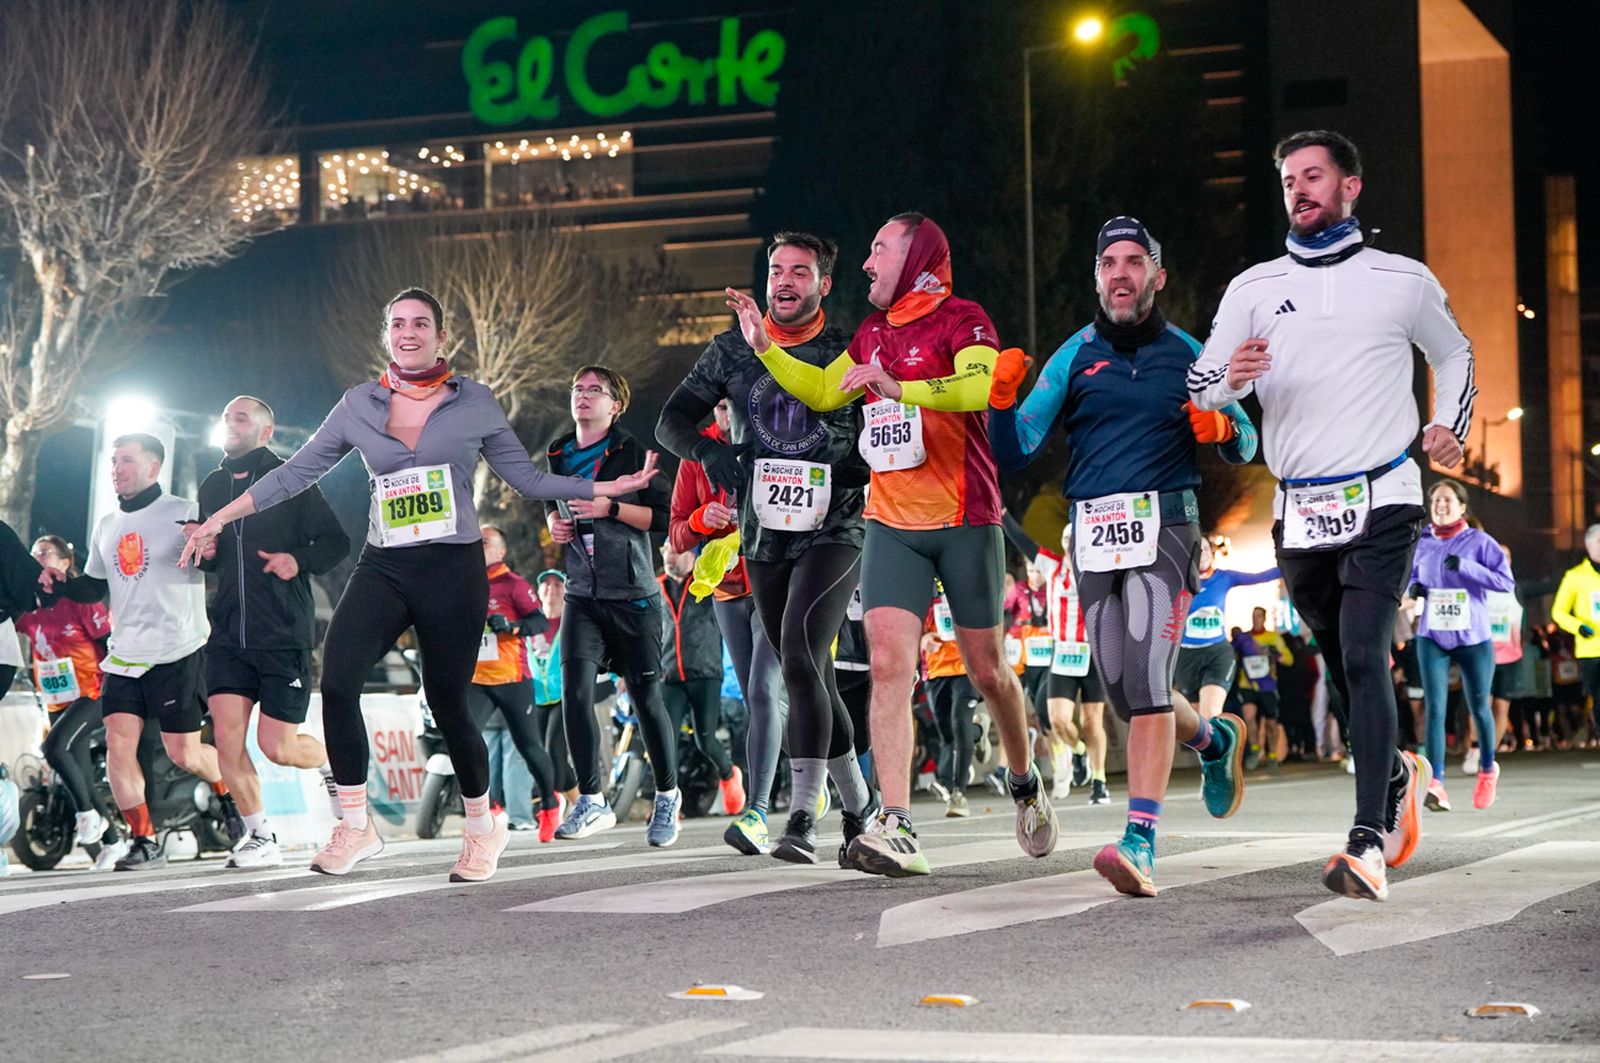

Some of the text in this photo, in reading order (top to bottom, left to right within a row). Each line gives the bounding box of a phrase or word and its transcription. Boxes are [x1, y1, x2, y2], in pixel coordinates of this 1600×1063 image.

[462, 11, 786, 125] El Corte
[870, 421, 911, 448] 5653
[770, 440, 781, 449] DE
[782, 443, 798, 451] SAN
[771, 466, 793, 475] NOCHE
[794, 467, 803, 476] DE
[391, 477, 410, 488] NOCHE
[411, 475, 420, 484] DE
[761, 474, 777, 483] SAN
[384, 489, 398, 499] SAN
[768, 484, 814, 507] 2421
[388, 491, 443, 520] 13789
[1116, 502, 1125, 511] DE
[1084, 514, 1101, 524] SAN
[1092, 520, 1144, 546] 2458
[374, 730, 416, 763] SAN
